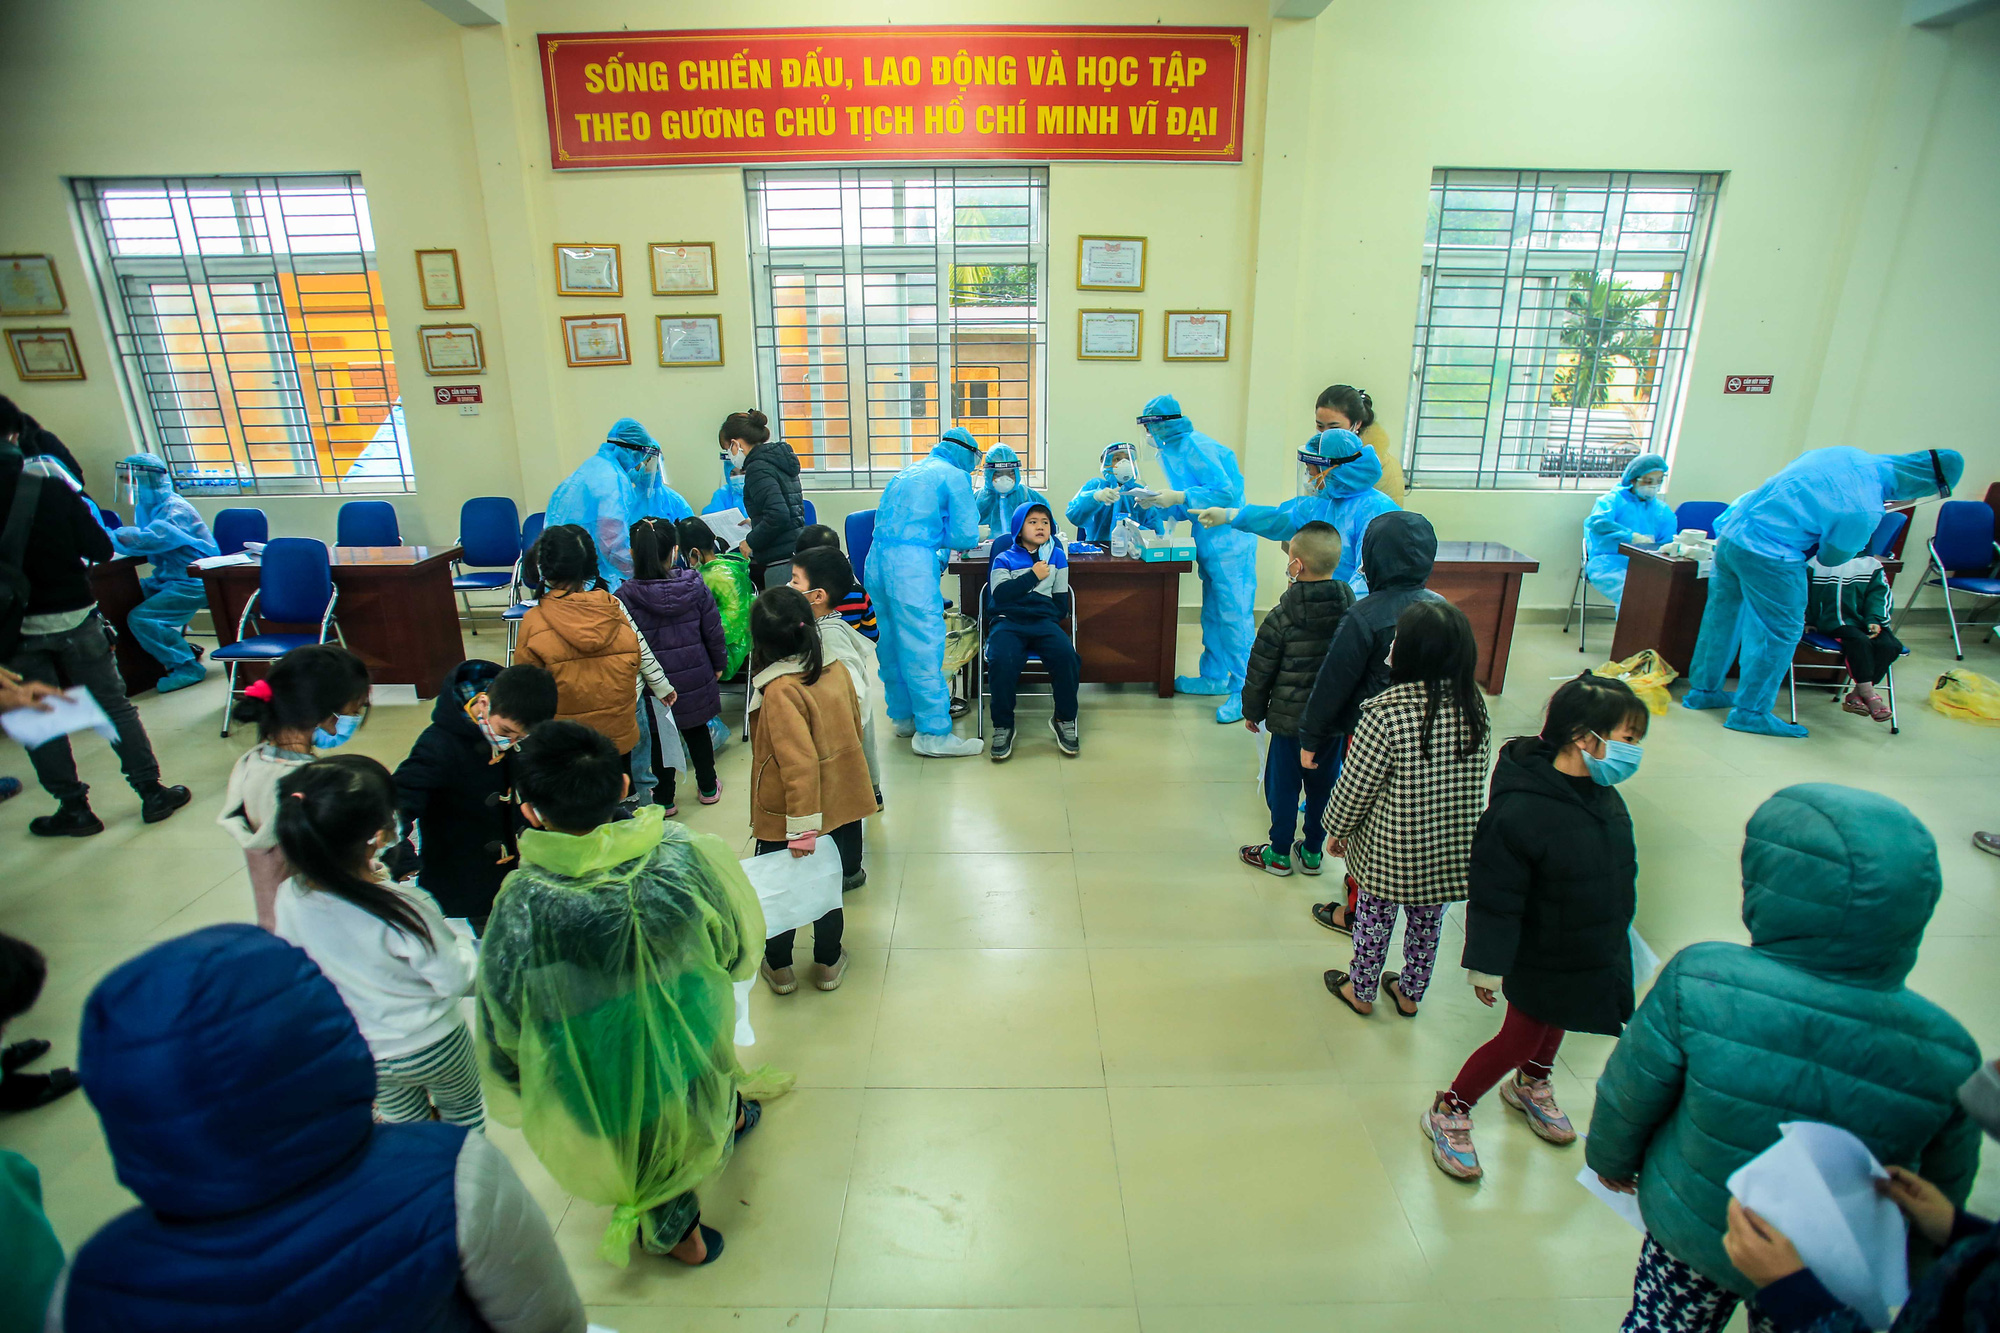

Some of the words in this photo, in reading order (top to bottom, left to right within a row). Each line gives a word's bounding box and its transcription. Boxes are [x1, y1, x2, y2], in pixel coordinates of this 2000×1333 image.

[584, 51, 669, 93] SỐNG
[678, 48, 772, 91] CHIẾN
[781, 46, 853, 91] ĐẤU,
[863, 55, 921, 87] LAO
[931, 49, 1017, 92] ĐỘNG
[1026, 49, 1067, 86] VÀ
[1077, 55, 1139, 93] HỌC
[1149, 50, 1207, 93] TẬP
[575, 110, 651, 143] THEO
[660, 106, 766, 140] GƯƠNG
[774, 94, 836, 137] CHỦ
[845, 105, 914, 142] TỊCH
[924, 94, 964, 135] HỒ
[975, 99, 1026, 135] CHÍ
[1037, 105, 1118, 135] MINH
[1128, 100, 1160, 135] VĨ
[1166, 106, 1218, 142] ĐẠI
